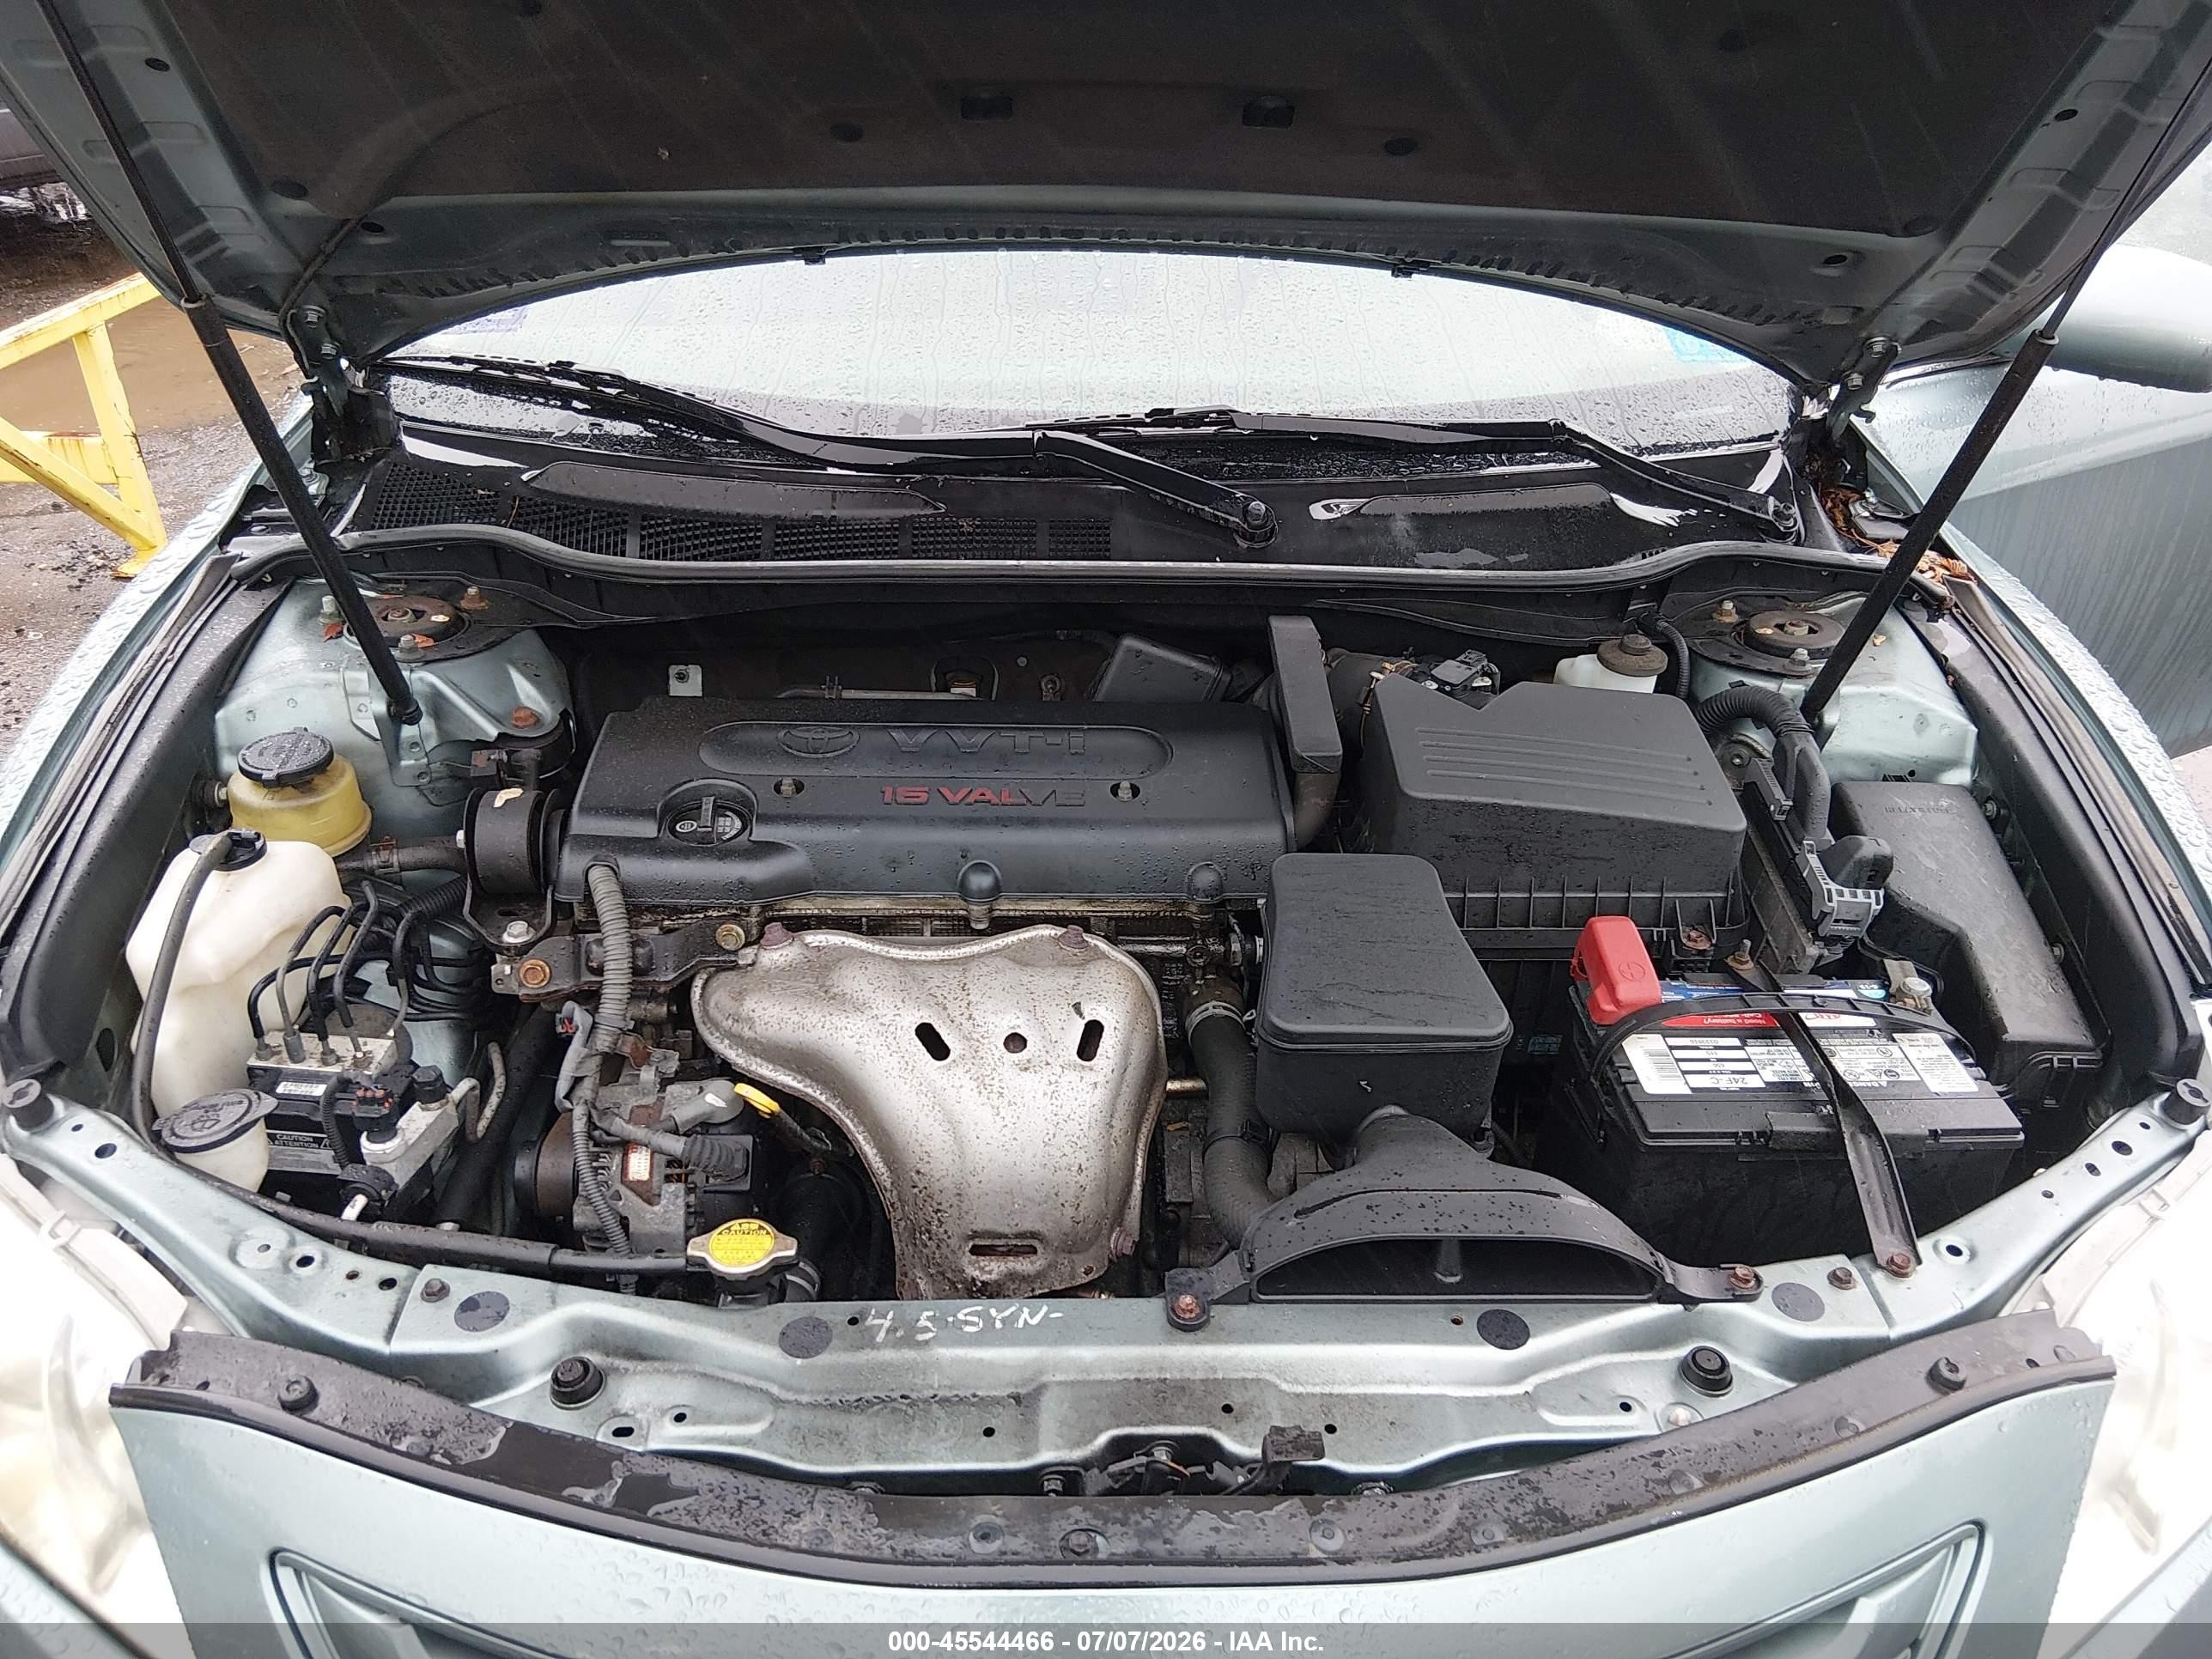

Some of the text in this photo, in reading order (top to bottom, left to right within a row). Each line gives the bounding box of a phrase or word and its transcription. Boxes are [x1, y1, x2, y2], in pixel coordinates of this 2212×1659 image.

[881, 786, 1086, 807] 16 VALVE
[276, 1133, 313, 1142] CAUTION
[274, 1139, 319, 1148] ATTENTION
